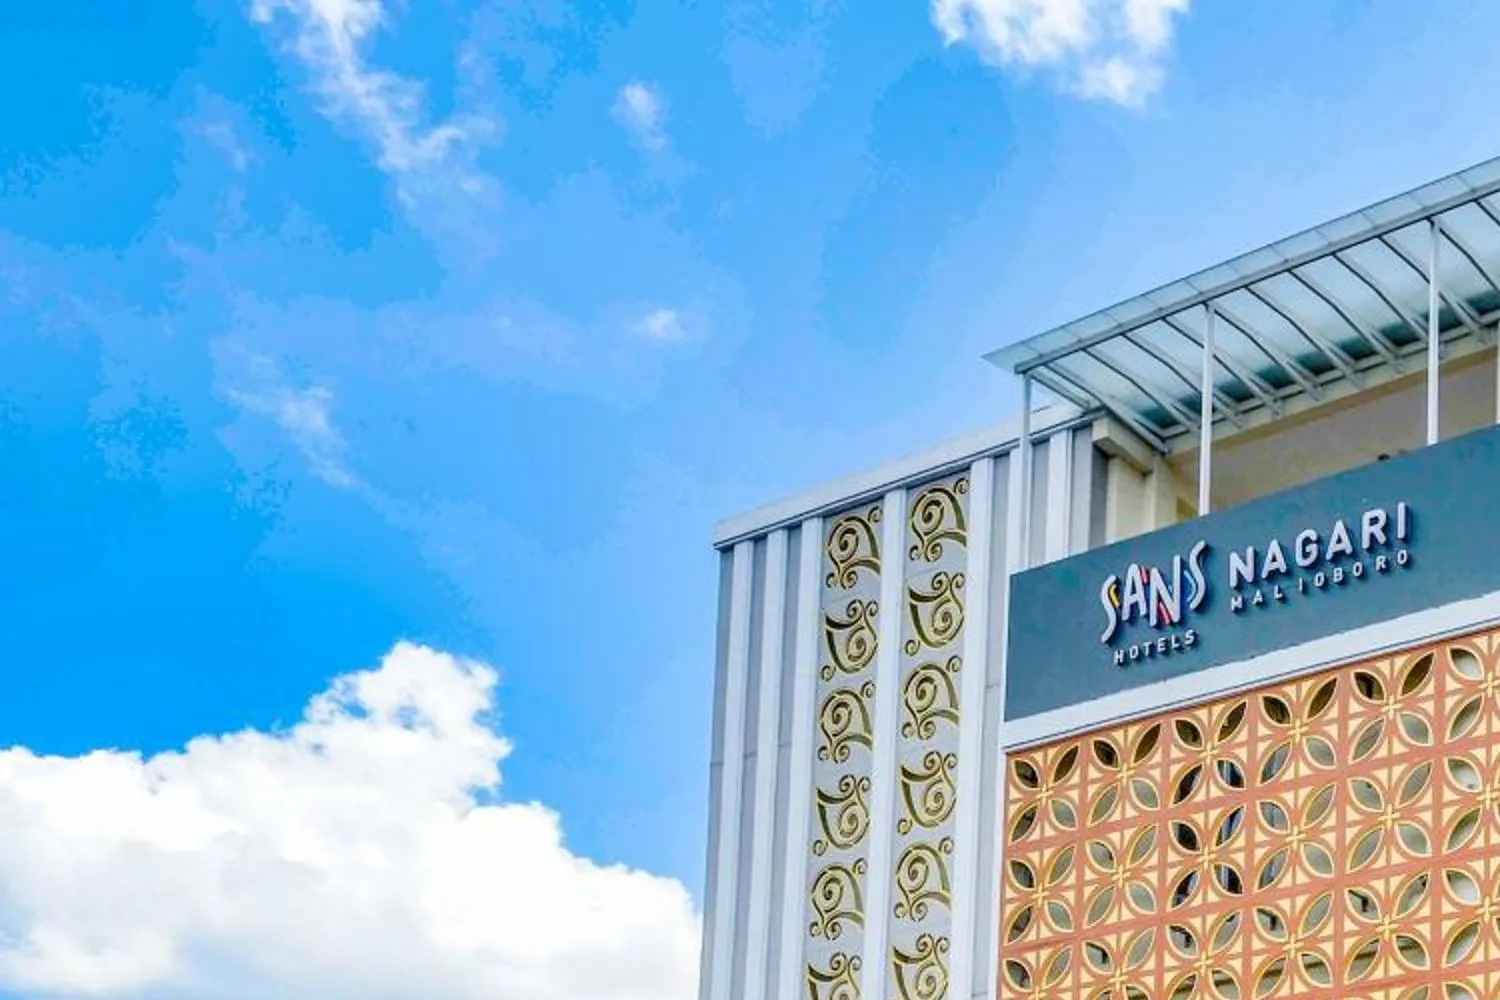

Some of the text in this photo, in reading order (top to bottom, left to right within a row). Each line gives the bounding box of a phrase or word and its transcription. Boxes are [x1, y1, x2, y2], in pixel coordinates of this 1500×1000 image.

[1229, 502, 1407, 588] NAGARI
[1101, 540, 1207, 643] SANS
[1114, 629, 1195, 664] HOTELS
